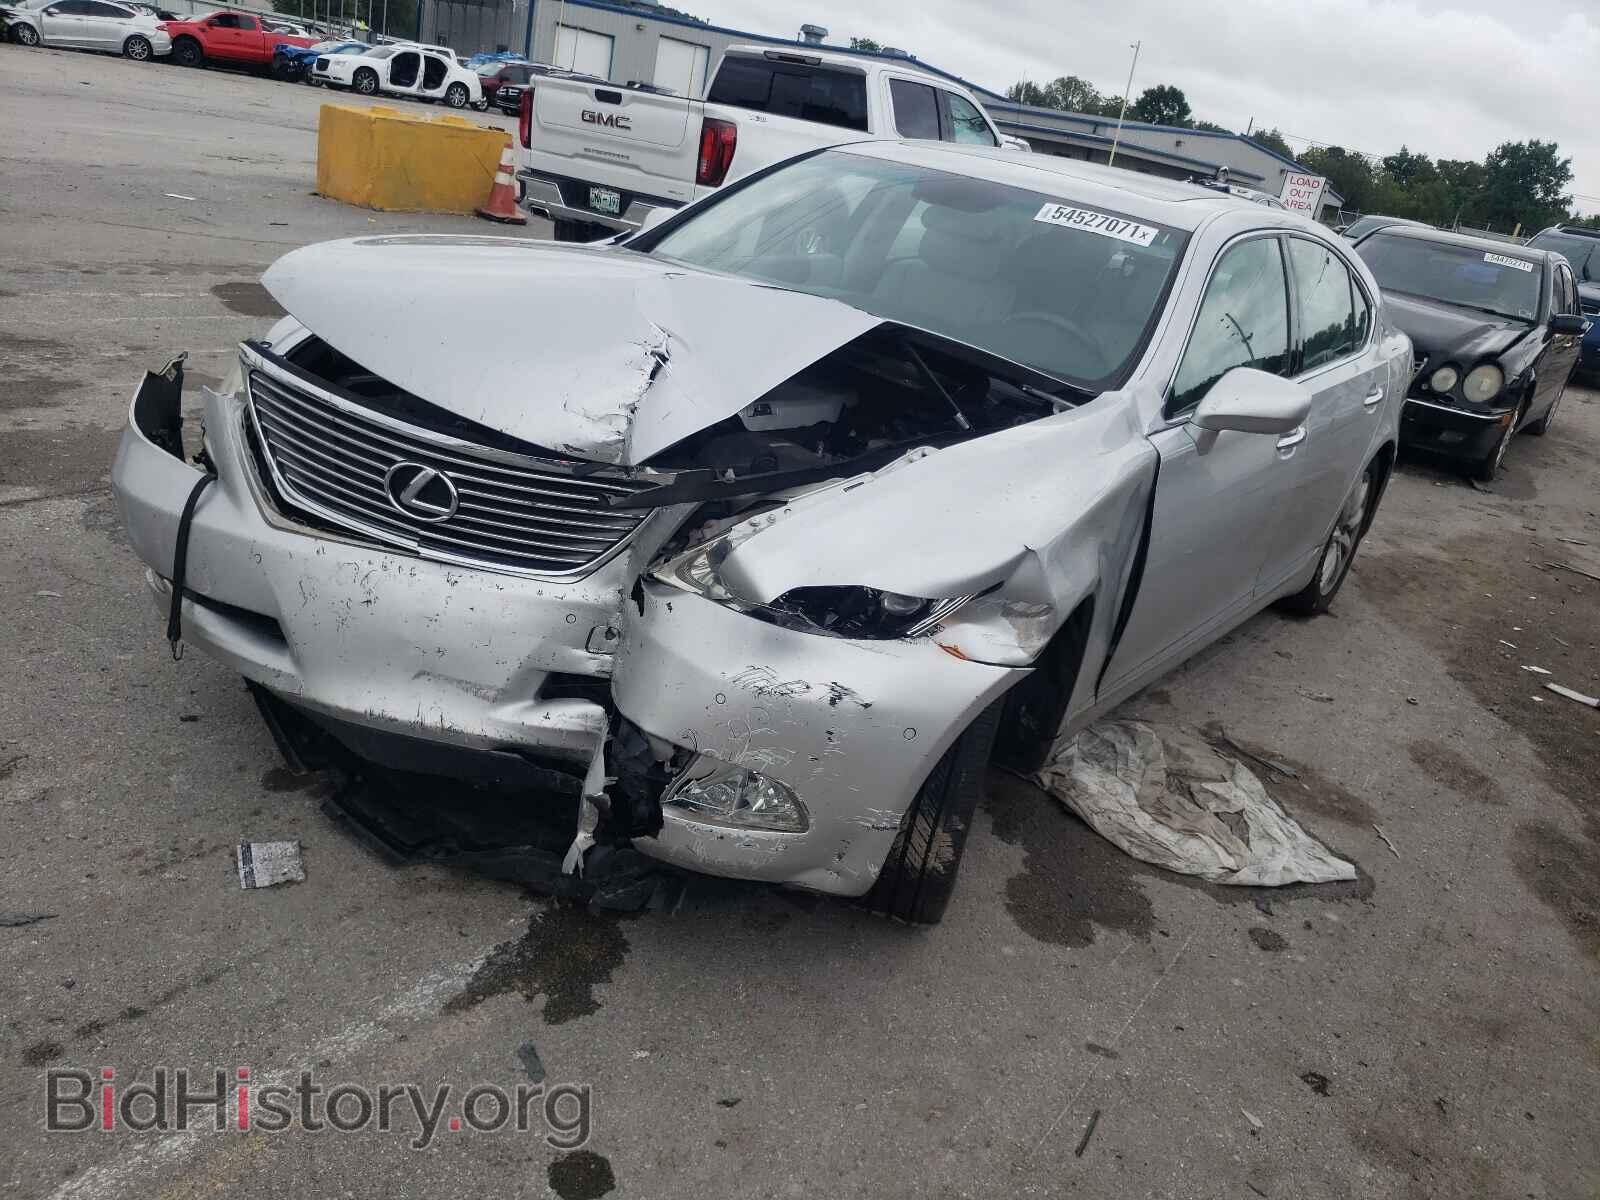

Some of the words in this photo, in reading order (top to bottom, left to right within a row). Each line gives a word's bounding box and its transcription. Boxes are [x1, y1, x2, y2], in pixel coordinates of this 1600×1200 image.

[581, 109, 632, 131] GMC
[1290, 175, 1320, 188] LOAD
[1290, 188, 1313, 200] OUT
[1283, 199, 1312, 211] AREA
